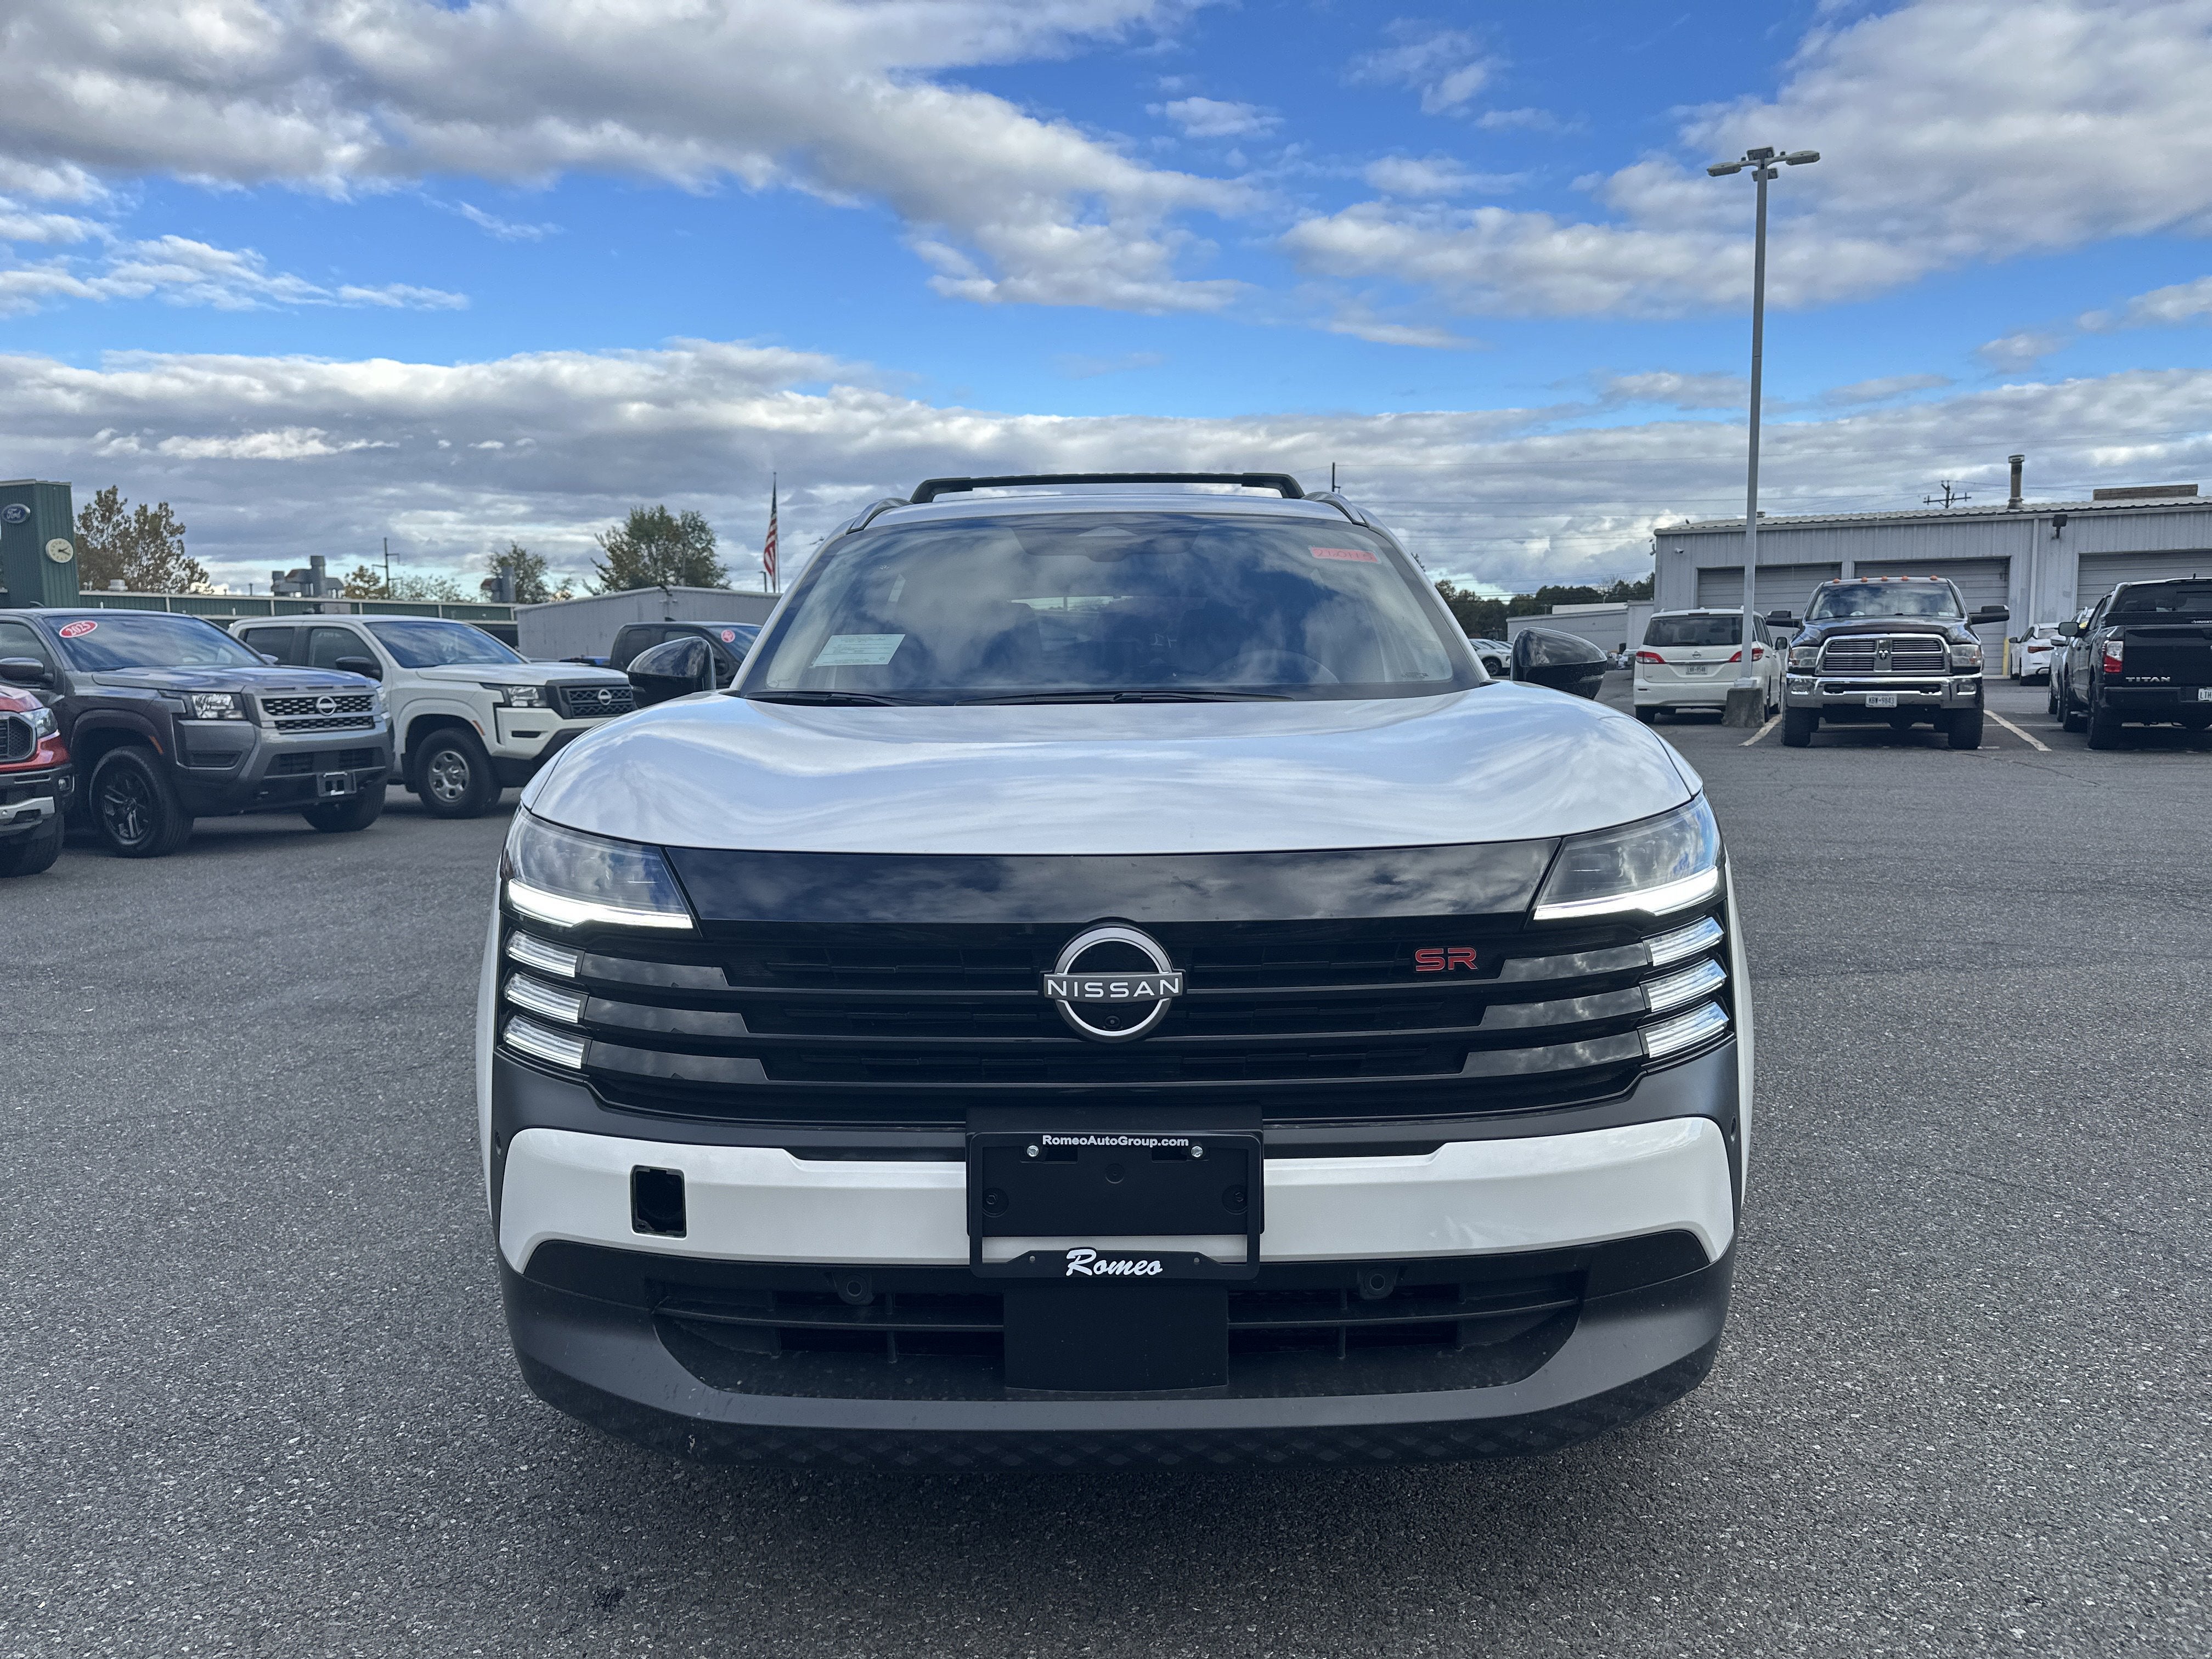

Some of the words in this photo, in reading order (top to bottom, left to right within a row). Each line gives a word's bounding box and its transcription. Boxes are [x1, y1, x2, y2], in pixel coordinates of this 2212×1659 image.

[65, 622, 91, 636] 2025
[1415, 947, 1478, 971] SR
[1047, 978, 1179, 998] NISSAN
[1042, 1135, 1189, 1148] RomeoAutoGroup.com
[1066, 1249, 1163, 1276] Romeo
